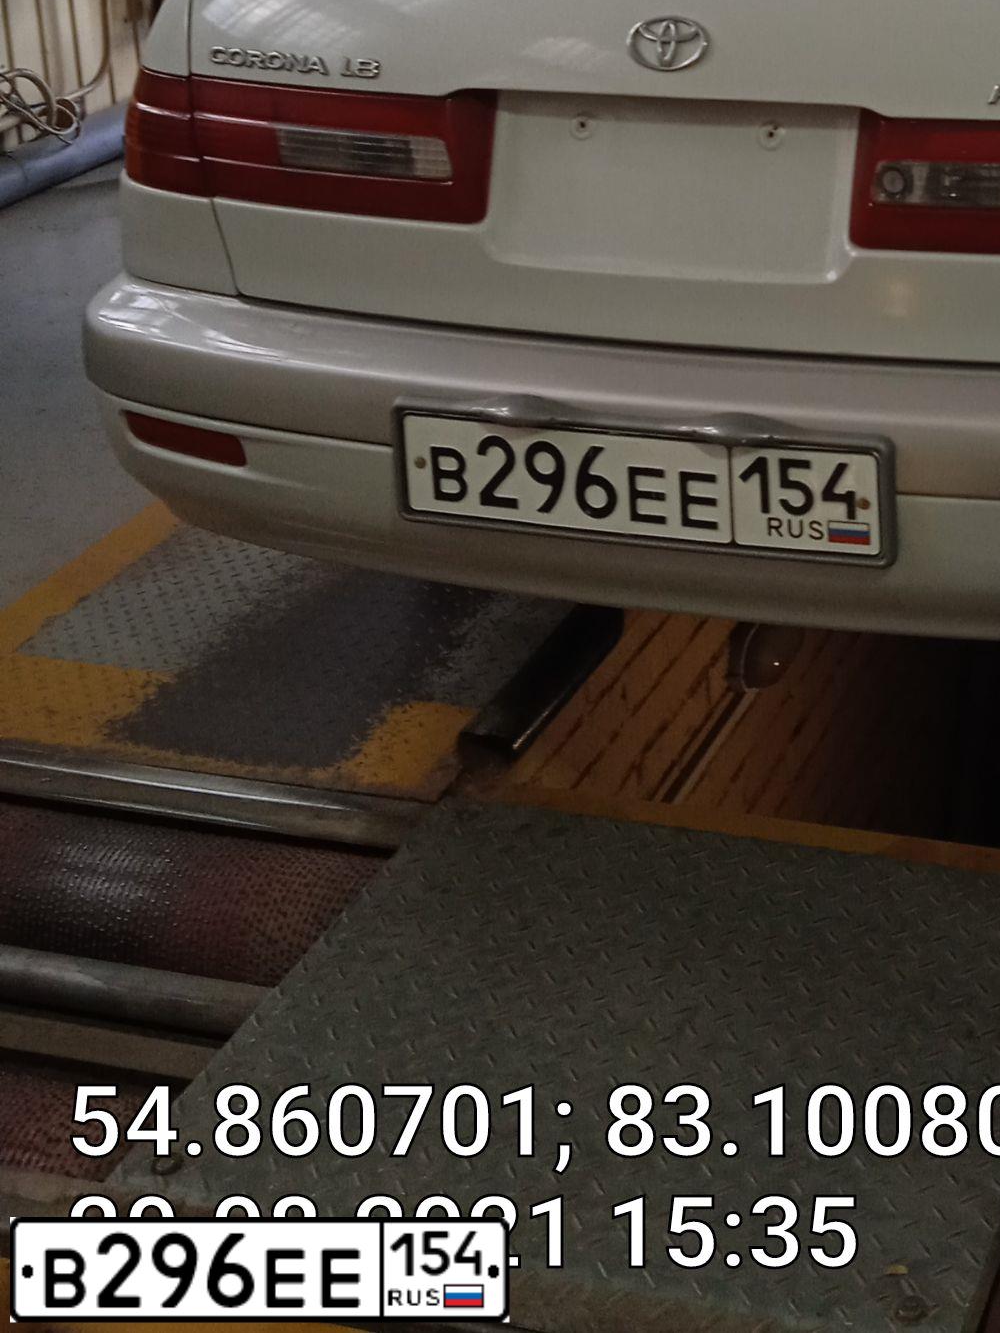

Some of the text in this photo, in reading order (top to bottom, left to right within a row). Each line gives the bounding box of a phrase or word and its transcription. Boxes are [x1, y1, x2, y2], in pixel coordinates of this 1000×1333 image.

[210, 46, 330, 76] CORONA
[738, 457, 858, 520] 154
[767, 517, 825, 541] RUS
